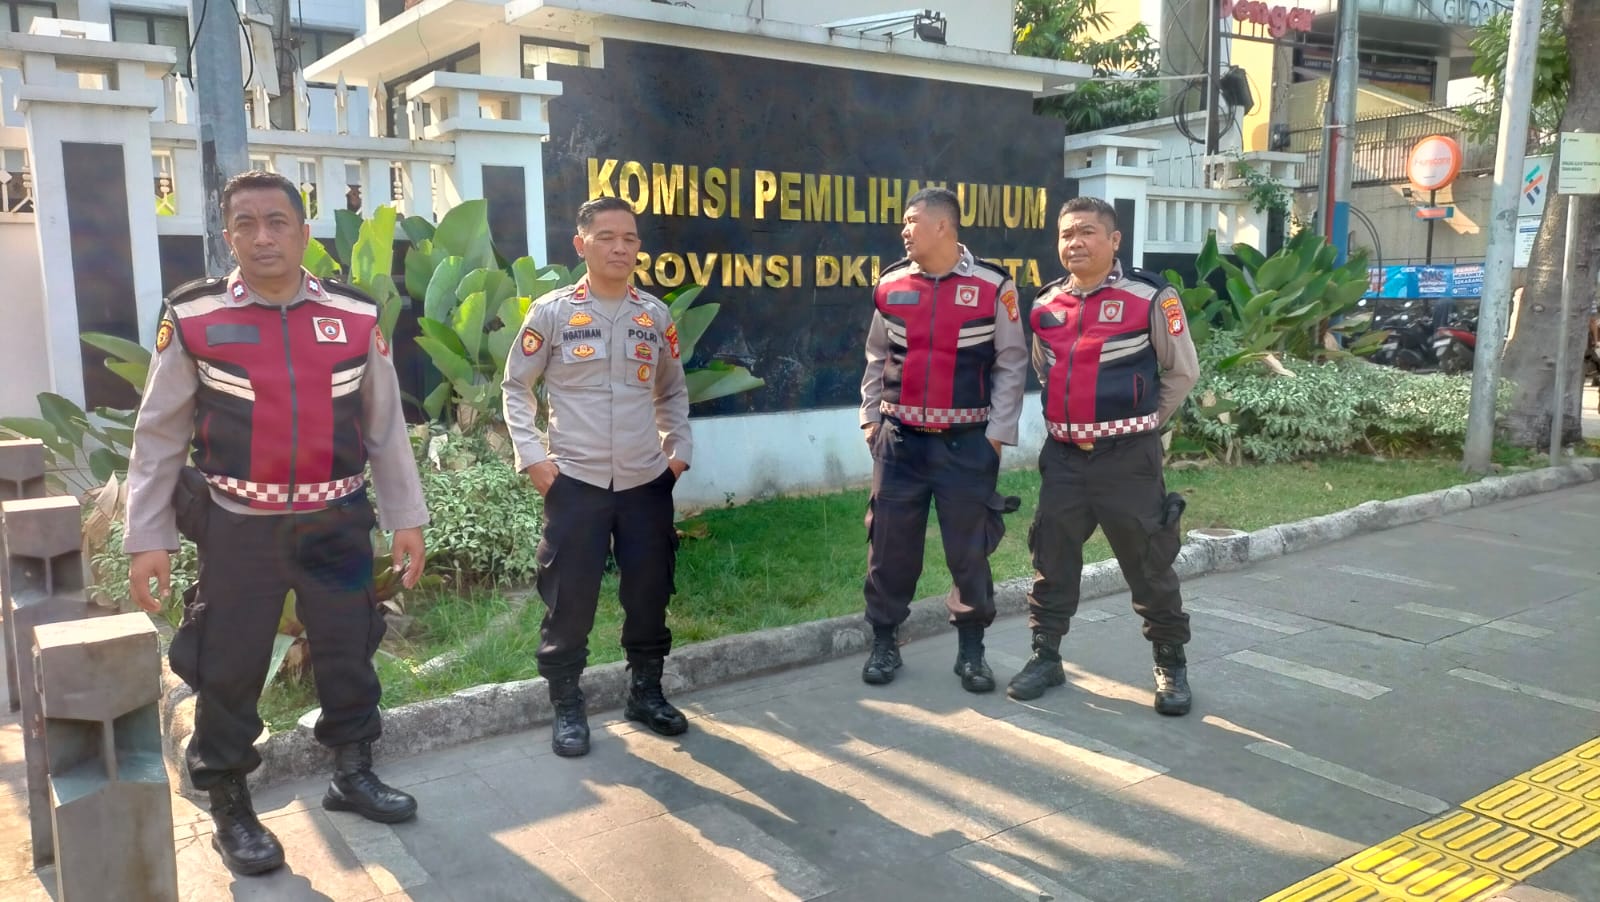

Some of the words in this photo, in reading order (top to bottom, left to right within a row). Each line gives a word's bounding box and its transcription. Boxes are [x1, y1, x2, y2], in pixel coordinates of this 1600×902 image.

[587, 157, 741, 220] KOMISI
[754, 169, 947, 224] PEMILIH
[957, 182, 1047, 230] UMUM
[628, 251, 802, 289] ROVINSI
[815, 255, 880, 287] DKI
[562, 328, 602, 341] NGATIMAN
[627, 328, 658, 343] POLRI
